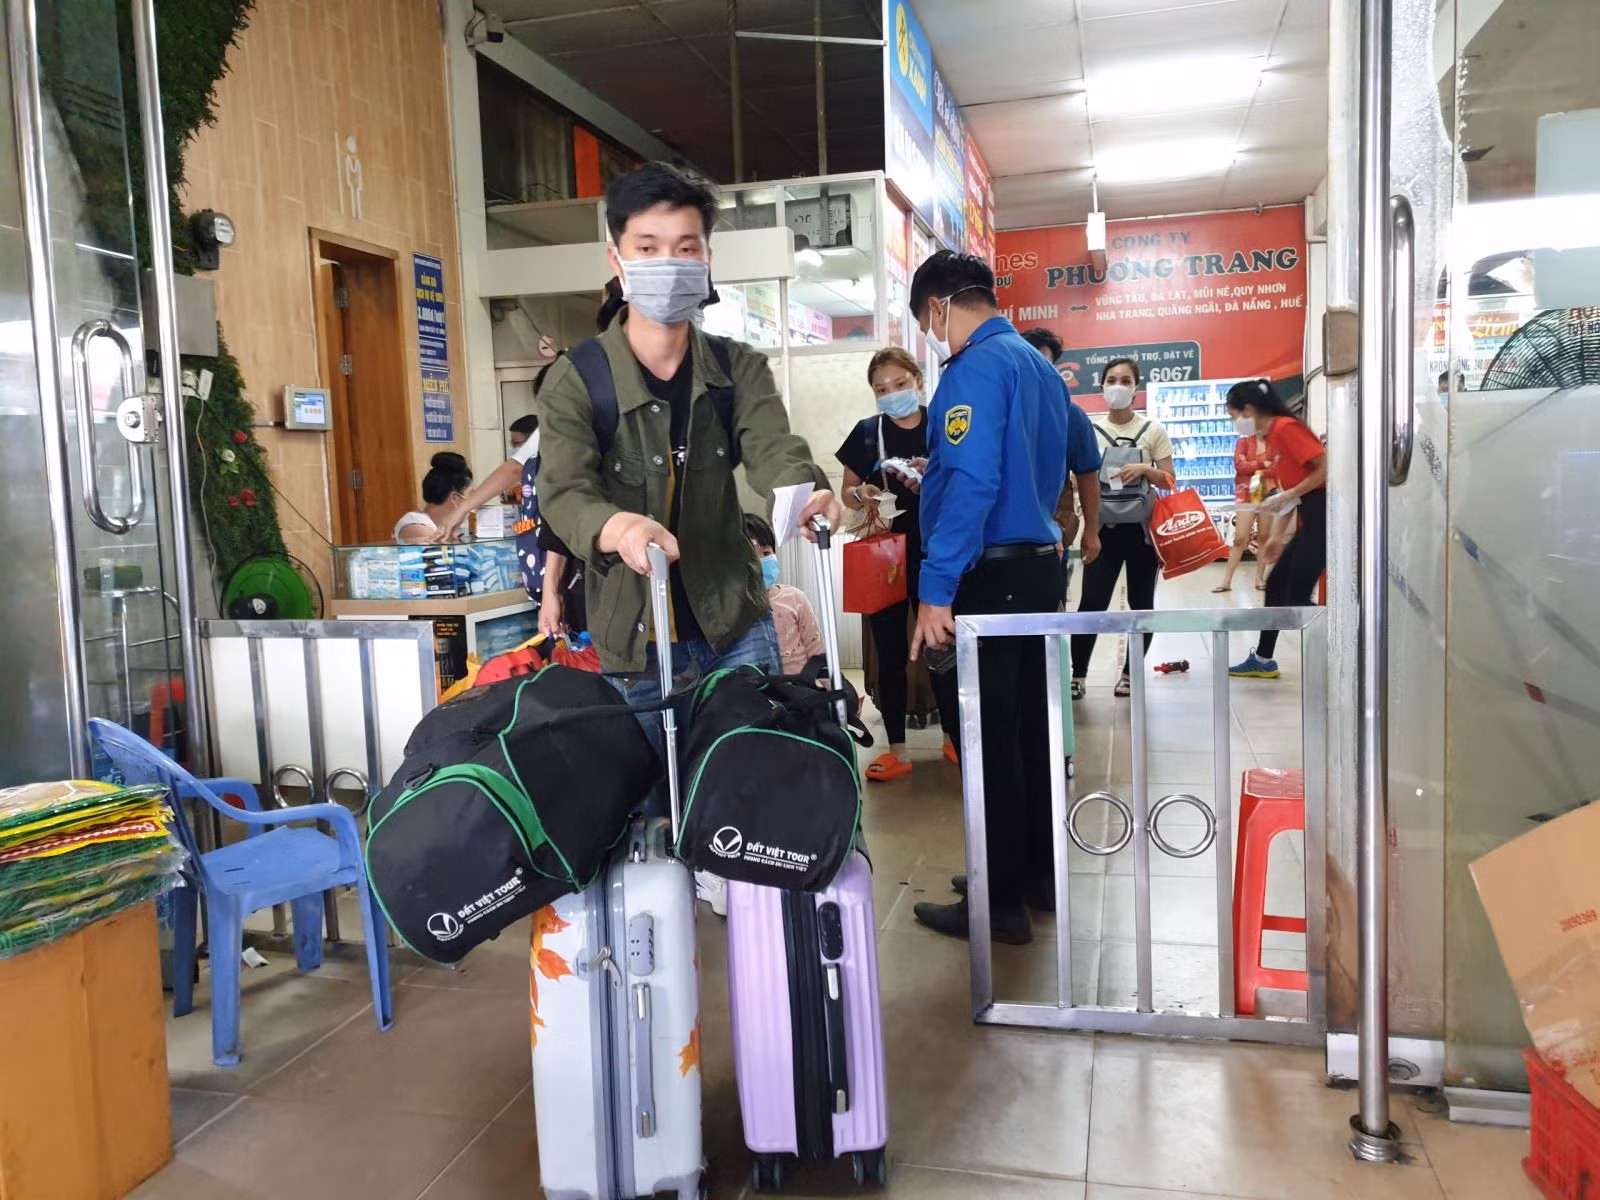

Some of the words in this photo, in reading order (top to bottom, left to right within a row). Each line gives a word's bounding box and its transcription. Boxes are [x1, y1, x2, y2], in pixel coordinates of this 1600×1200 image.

[1169, 231, 1191, 244] TY
[994, 251, 1038, 273] nes
[1046, 256, 1175, 288] PHƯƠNG
[1184, 247, 1299, 278] TRANG
[1258, 281, 1287, 294] NHƠN
[999, 305, 1014, 322] HÍ
[1018, 305, 1059, 321] MINH
[1096, 310, 1116, 321] NHA
[1280, 293, 1304, 309] HUẾ
[1183, 348, 1195, 359] VÉ
[1149, 365, 1193, 382] 6067
[766, 846, 786, 859] VIỆT
[475, 892, 496, 908] VIỆT
